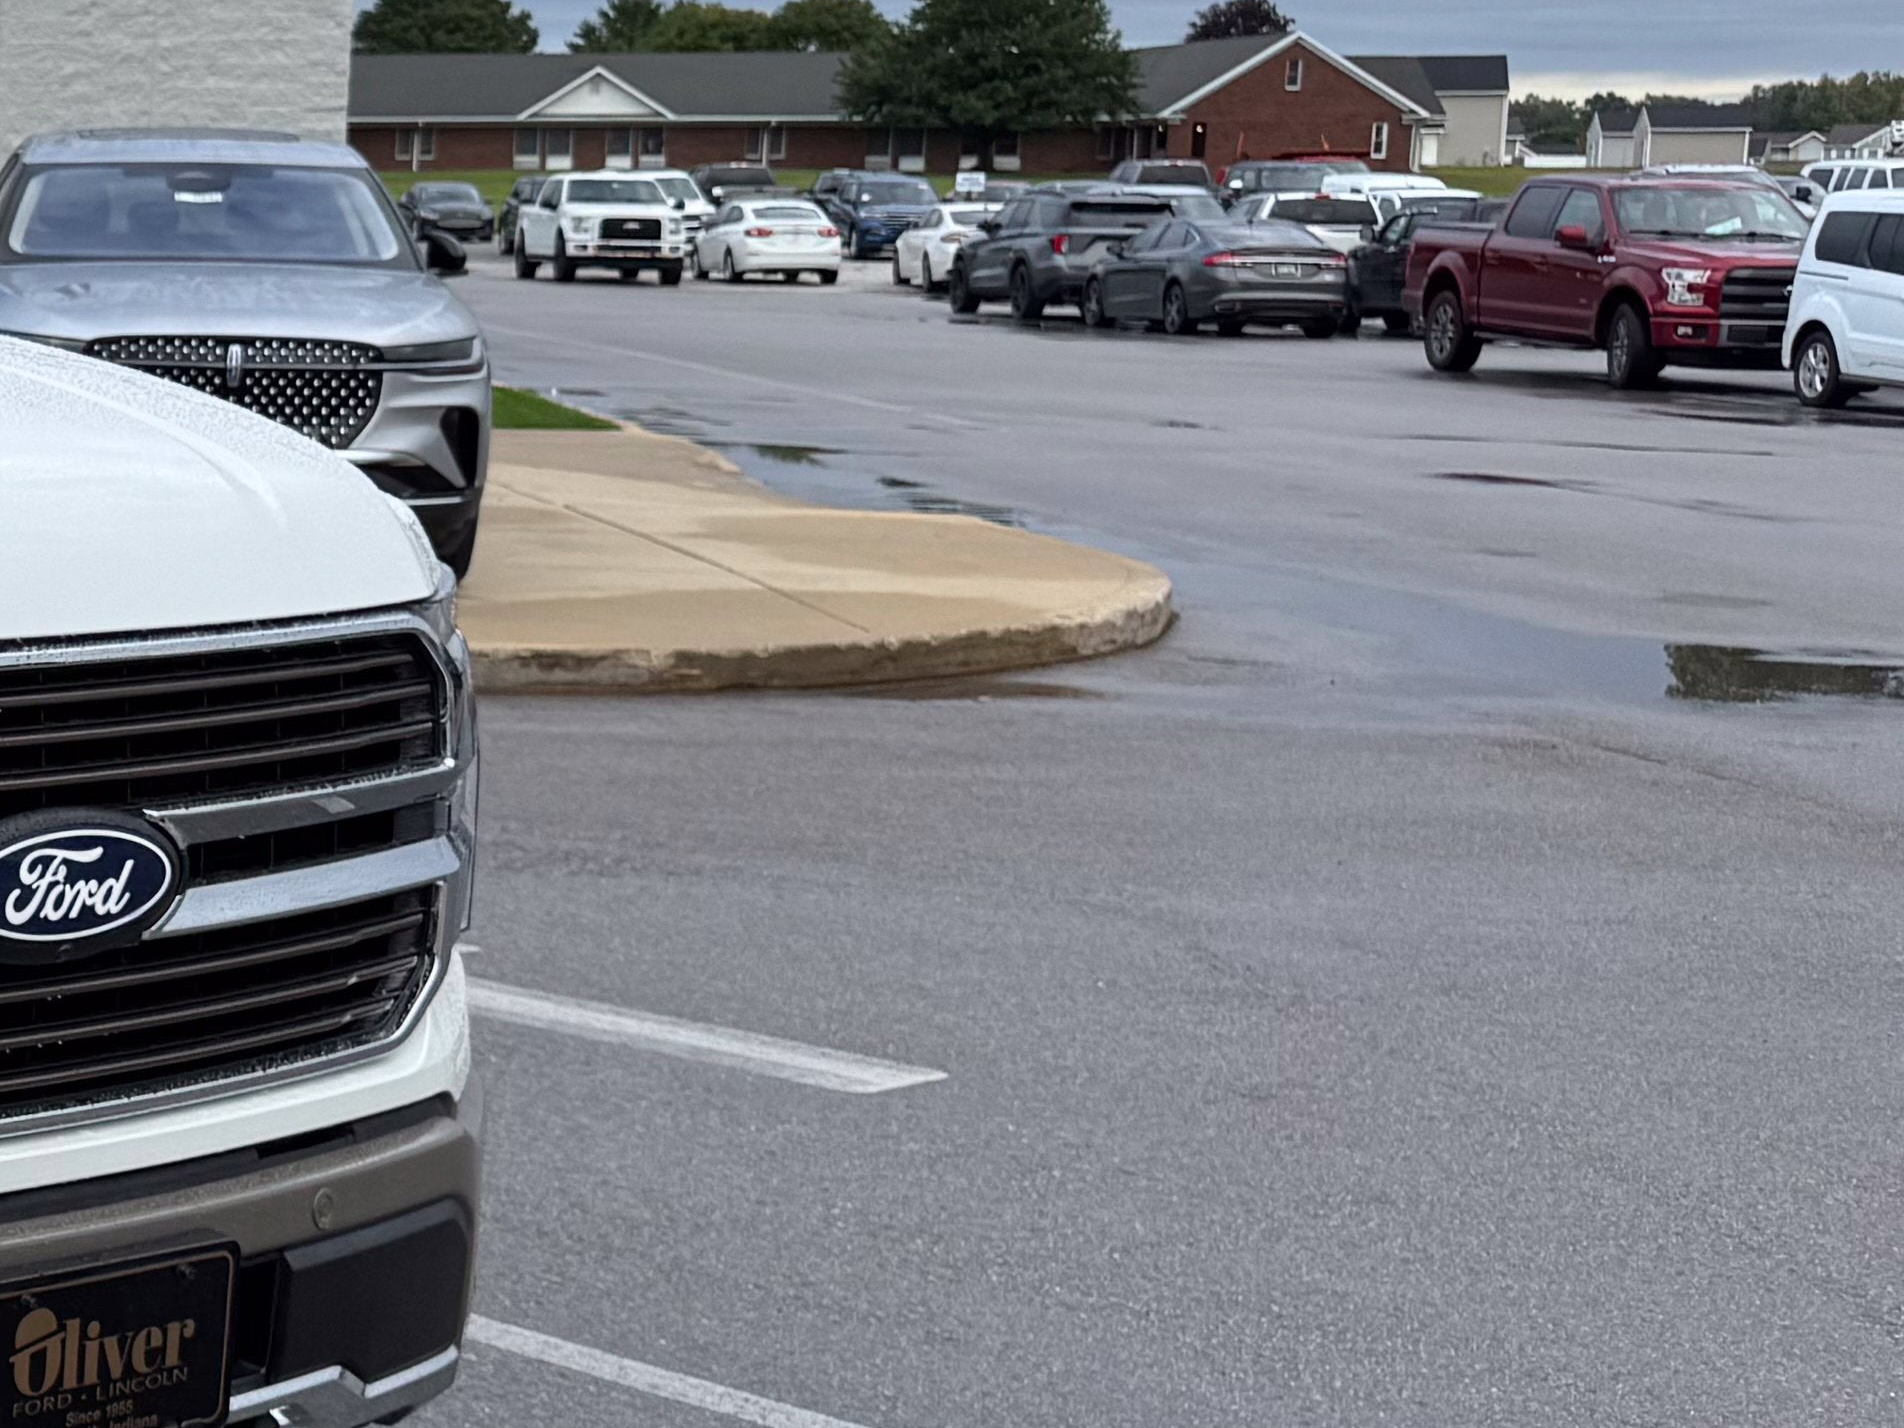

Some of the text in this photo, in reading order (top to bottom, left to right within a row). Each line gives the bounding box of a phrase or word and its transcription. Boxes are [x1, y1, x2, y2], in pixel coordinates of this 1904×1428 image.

[4, 845, 135, 926] Ford
[8, 1307, 196, 1398] Oliver
[12, 1367, 189, 1419] FORD LINCOLN
[65, 1410, 102, 1428] Since
